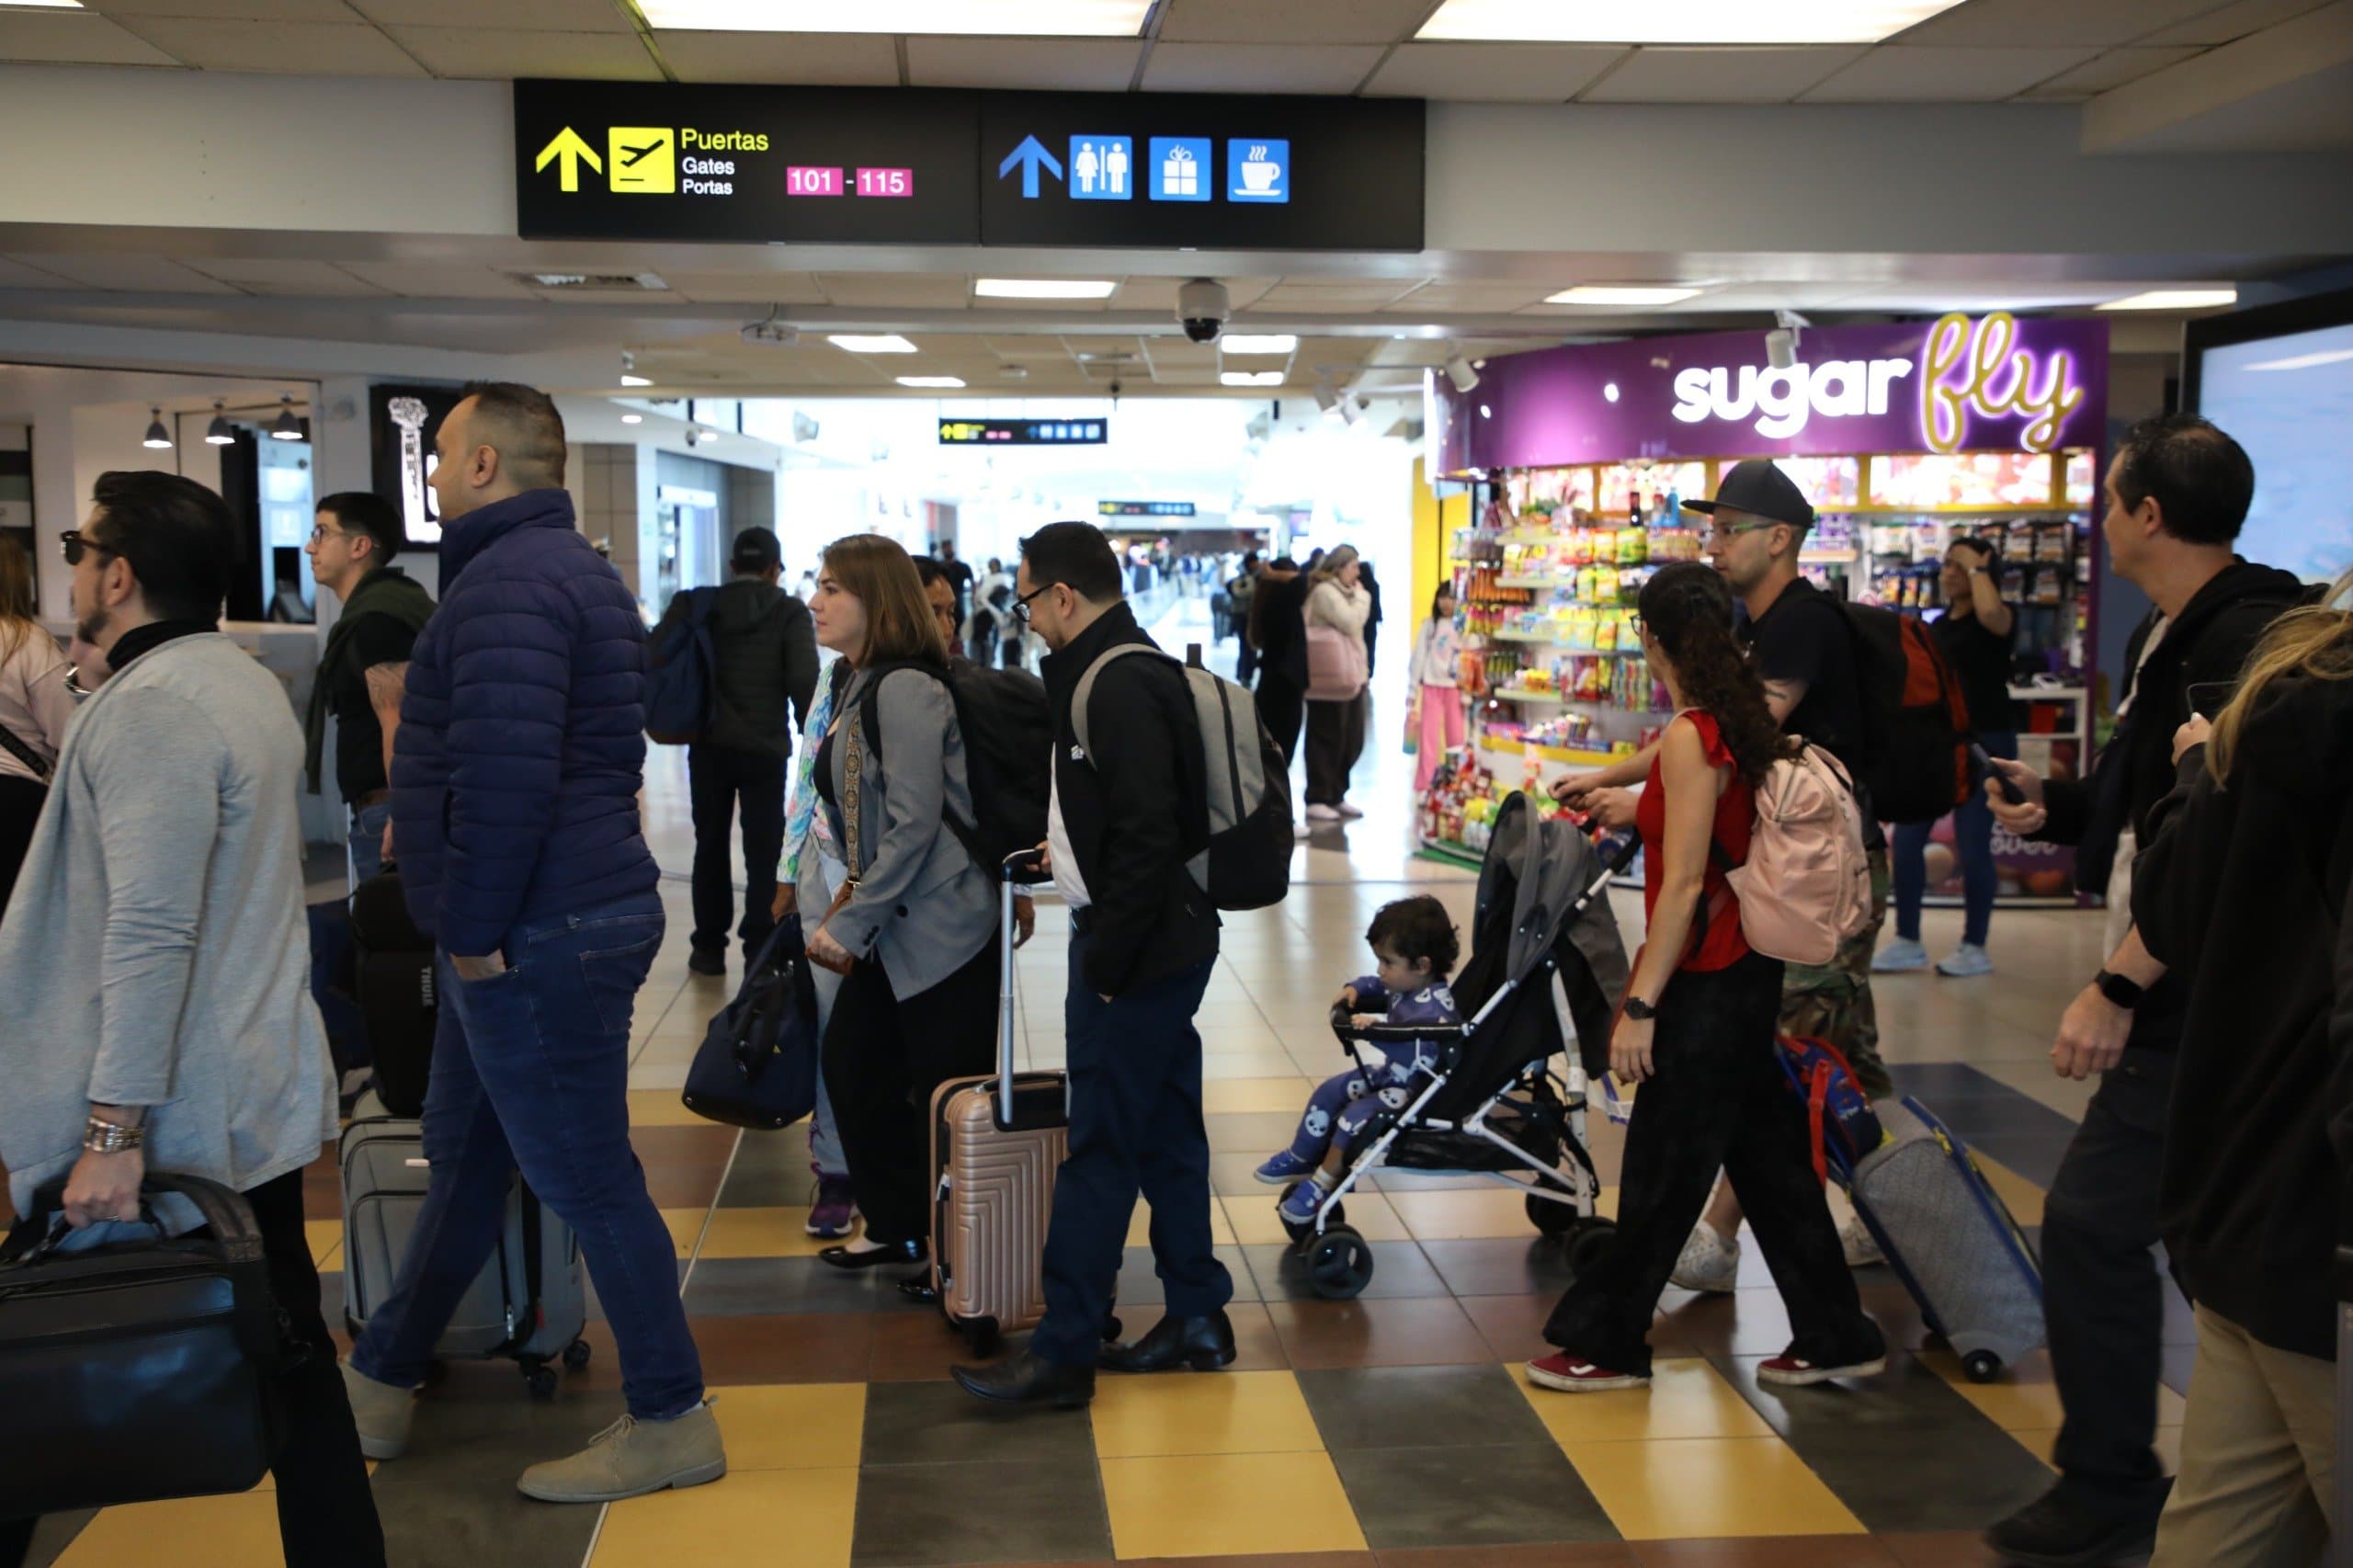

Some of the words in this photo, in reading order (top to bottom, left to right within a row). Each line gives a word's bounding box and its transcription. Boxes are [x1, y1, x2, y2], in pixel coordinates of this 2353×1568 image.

[681, 129, 769, 151] Puertas
[682, 156, 735, 175] Gates
[682, 177, 733, 196] Portas
[790, 169, 832, 192] 101
[861, 171, 905, 193] 115
[1671, 358, 1913, 439] sugar
[1923, 312, 2084, 453] fly
